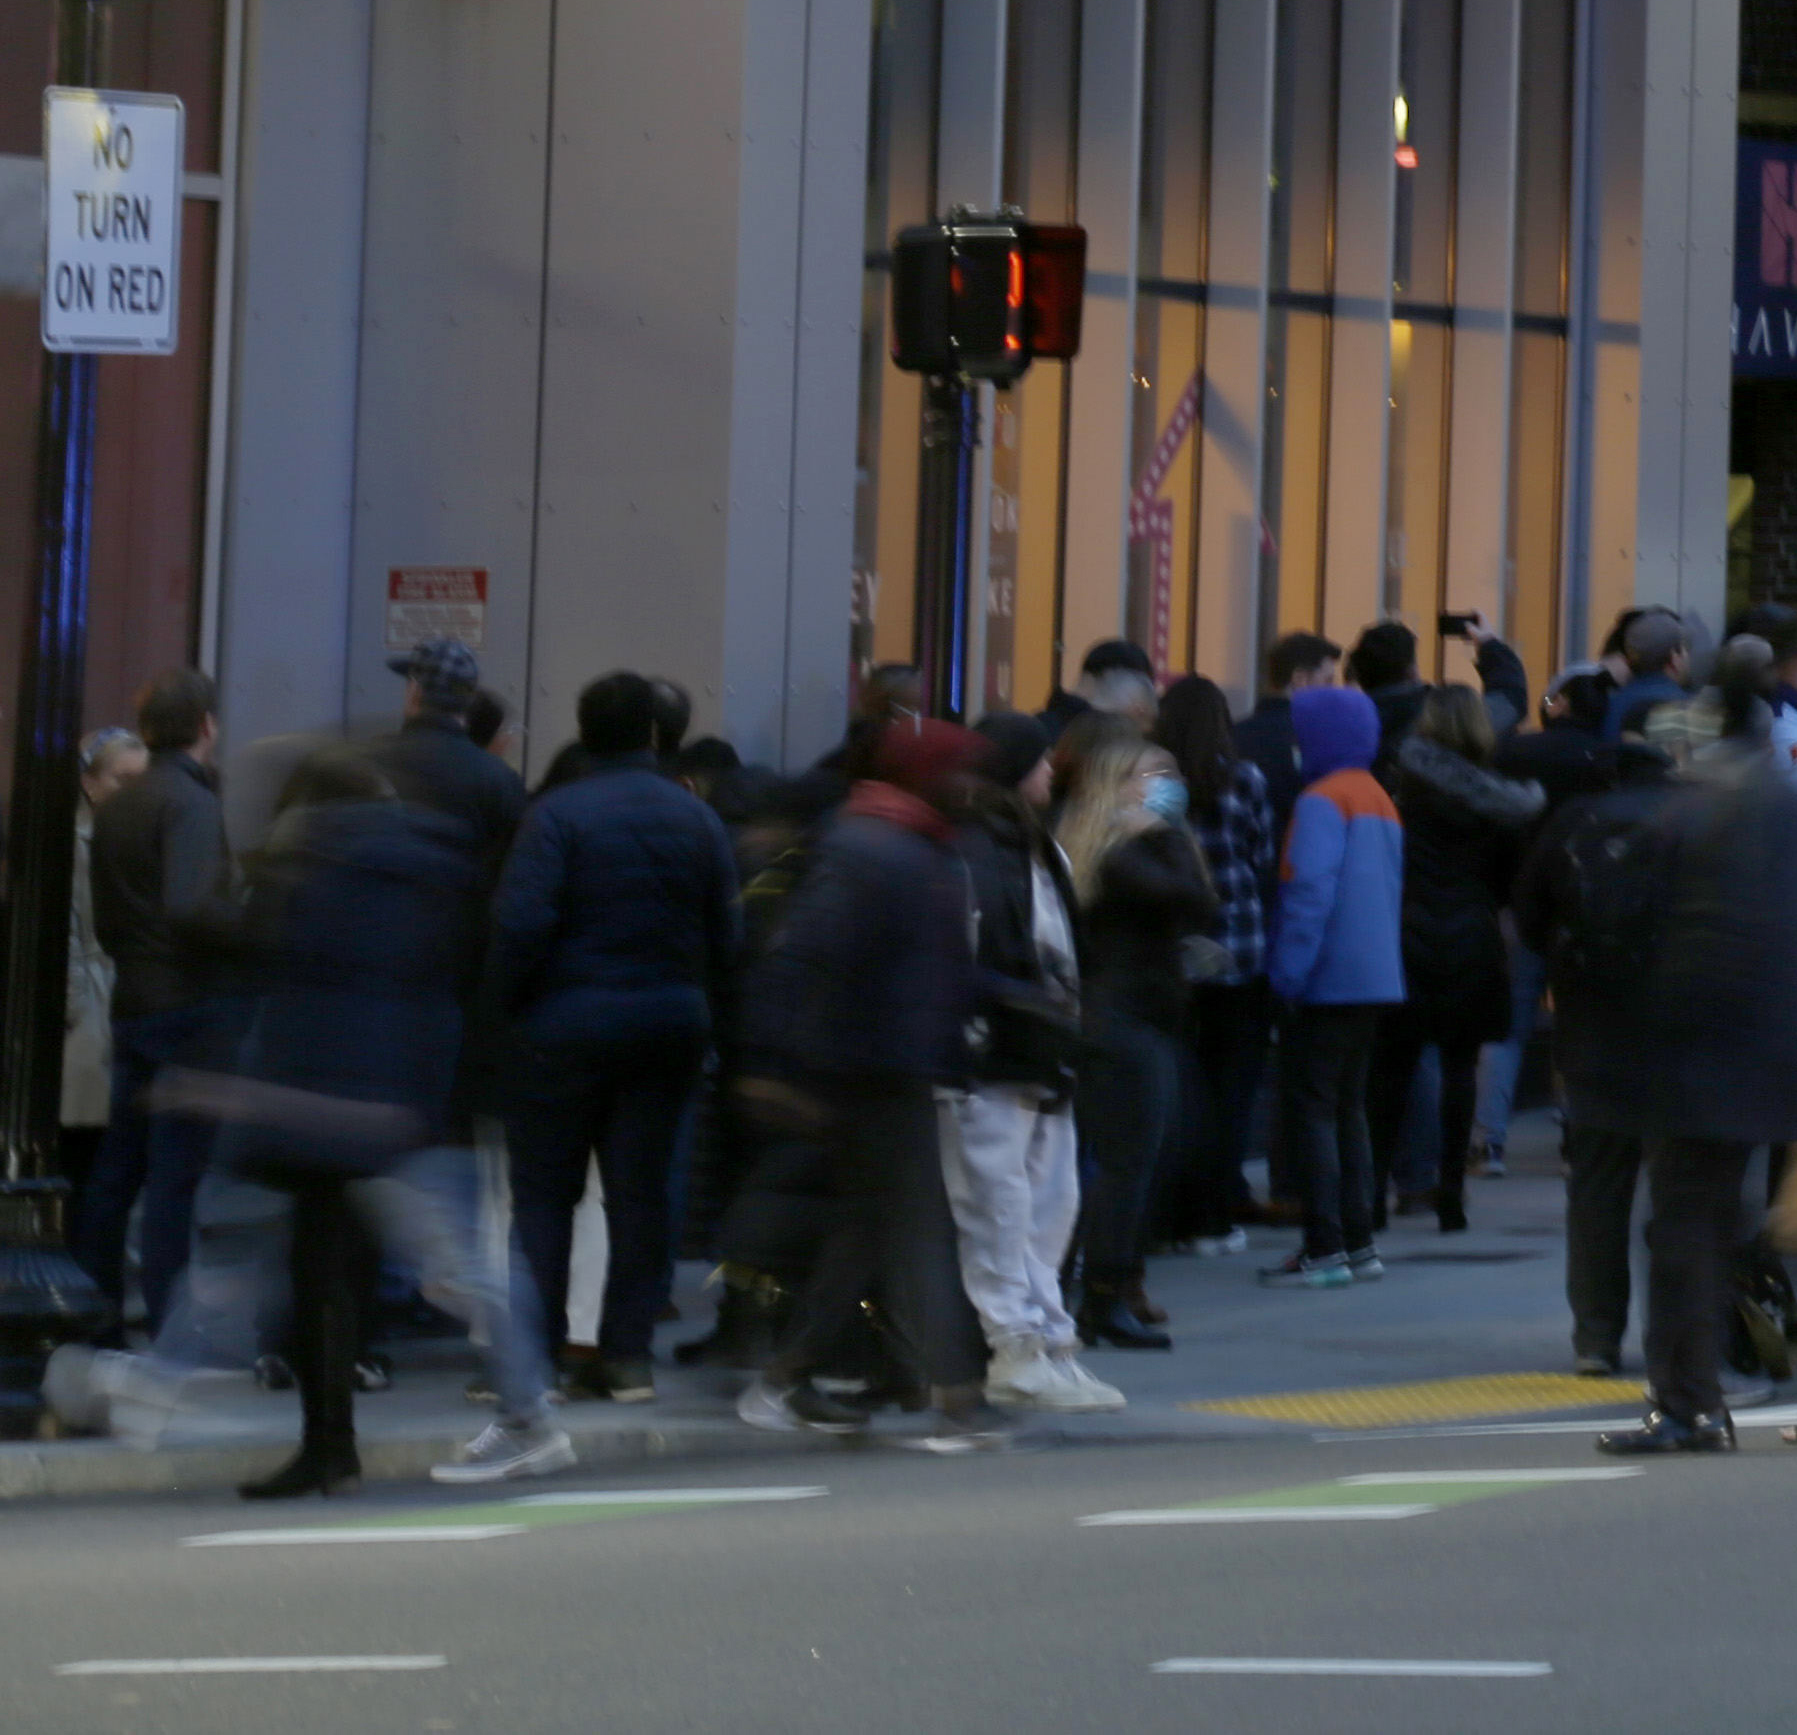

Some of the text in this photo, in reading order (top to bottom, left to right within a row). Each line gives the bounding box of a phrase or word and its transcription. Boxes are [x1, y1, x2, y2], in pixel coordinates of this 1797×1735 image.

[93, 122, 133, 171] NO
[73, 190, 152, 243] TURN
[54, 261, 165, 315] ON RED
